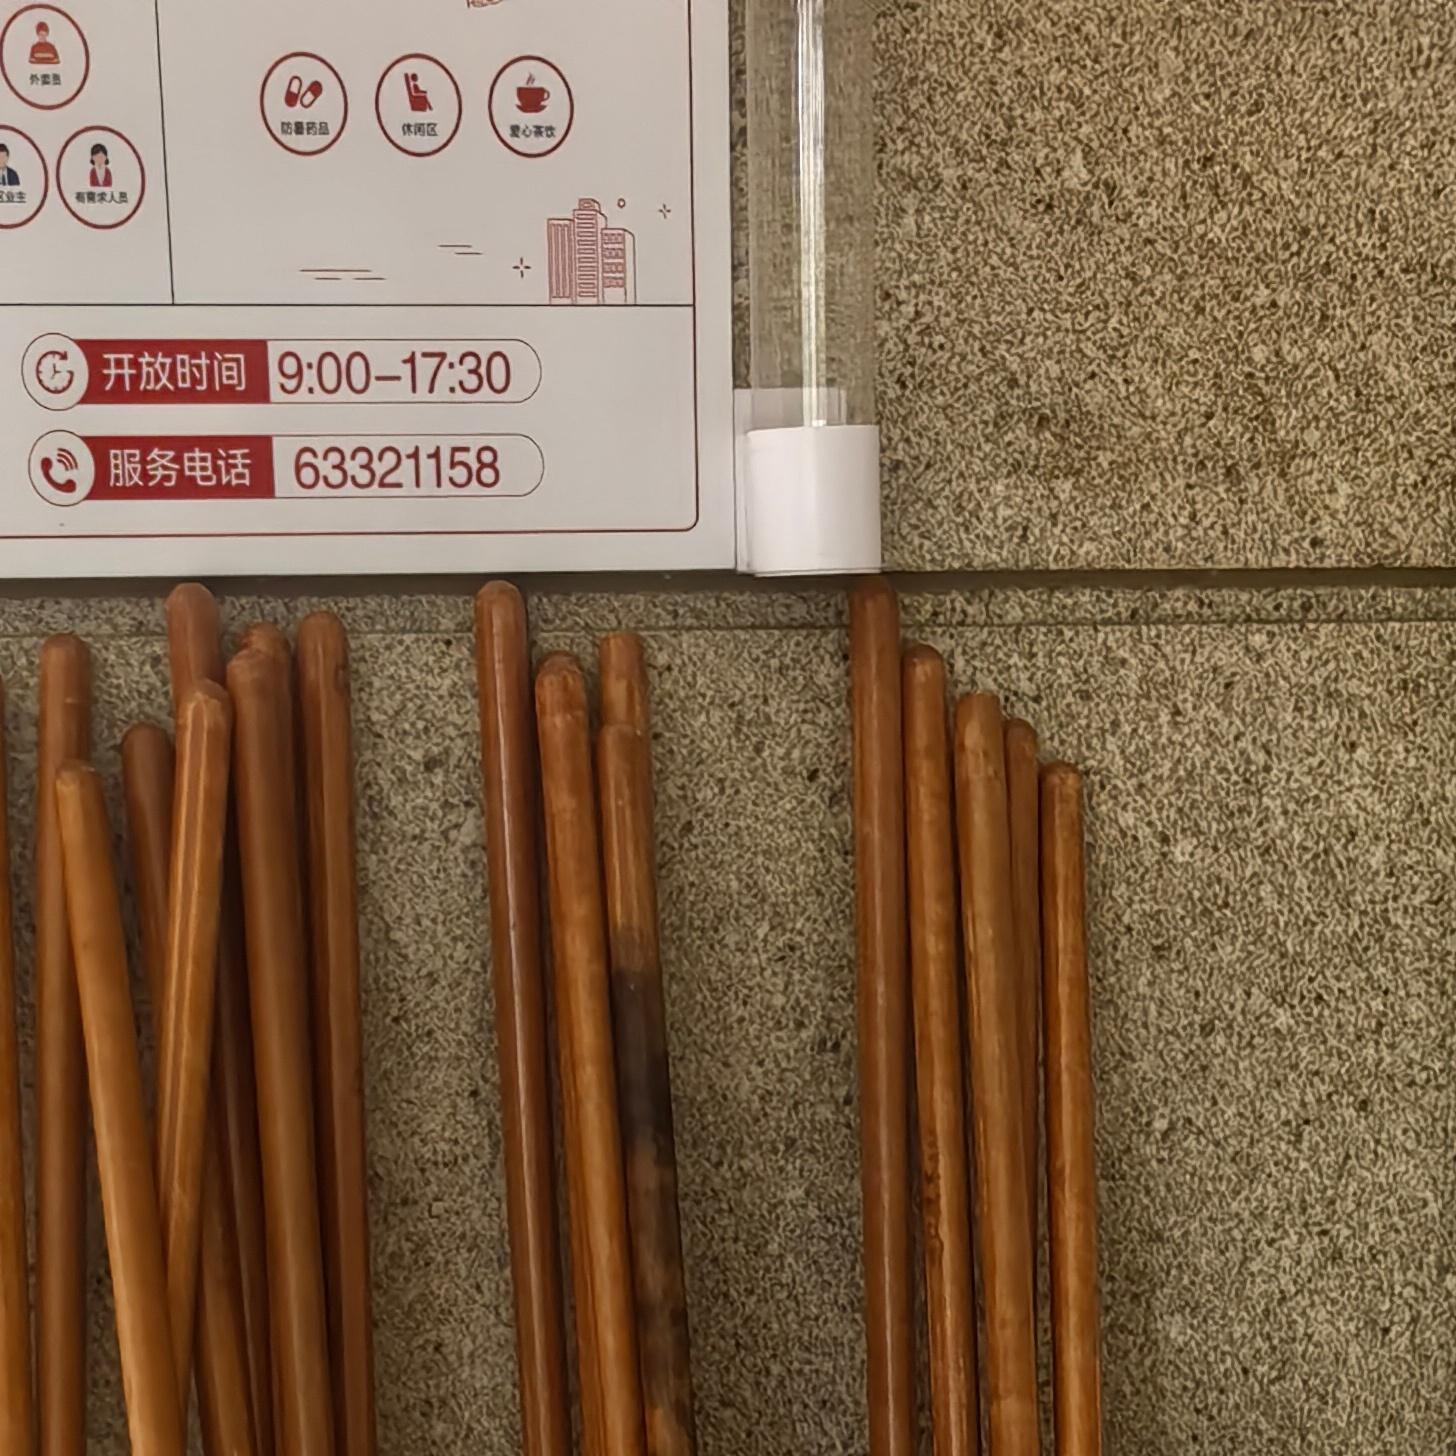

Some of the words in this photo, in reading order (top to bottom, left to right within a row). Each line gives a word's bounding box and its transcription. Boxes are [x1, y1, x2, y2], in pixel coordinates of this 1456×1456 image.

[280, 121, 330, 136] 防暑药品
[401, 122, 438, 137] 休闲区
[509, 124, 556, 139] 爱心茶饮
[101, 351, 246, 392] 开放时间
[276, 349, 511, 394] 9:00-17:30
[108, 447, 252, 488] 服务电话
[293, 445, 501, 490] 63321158
